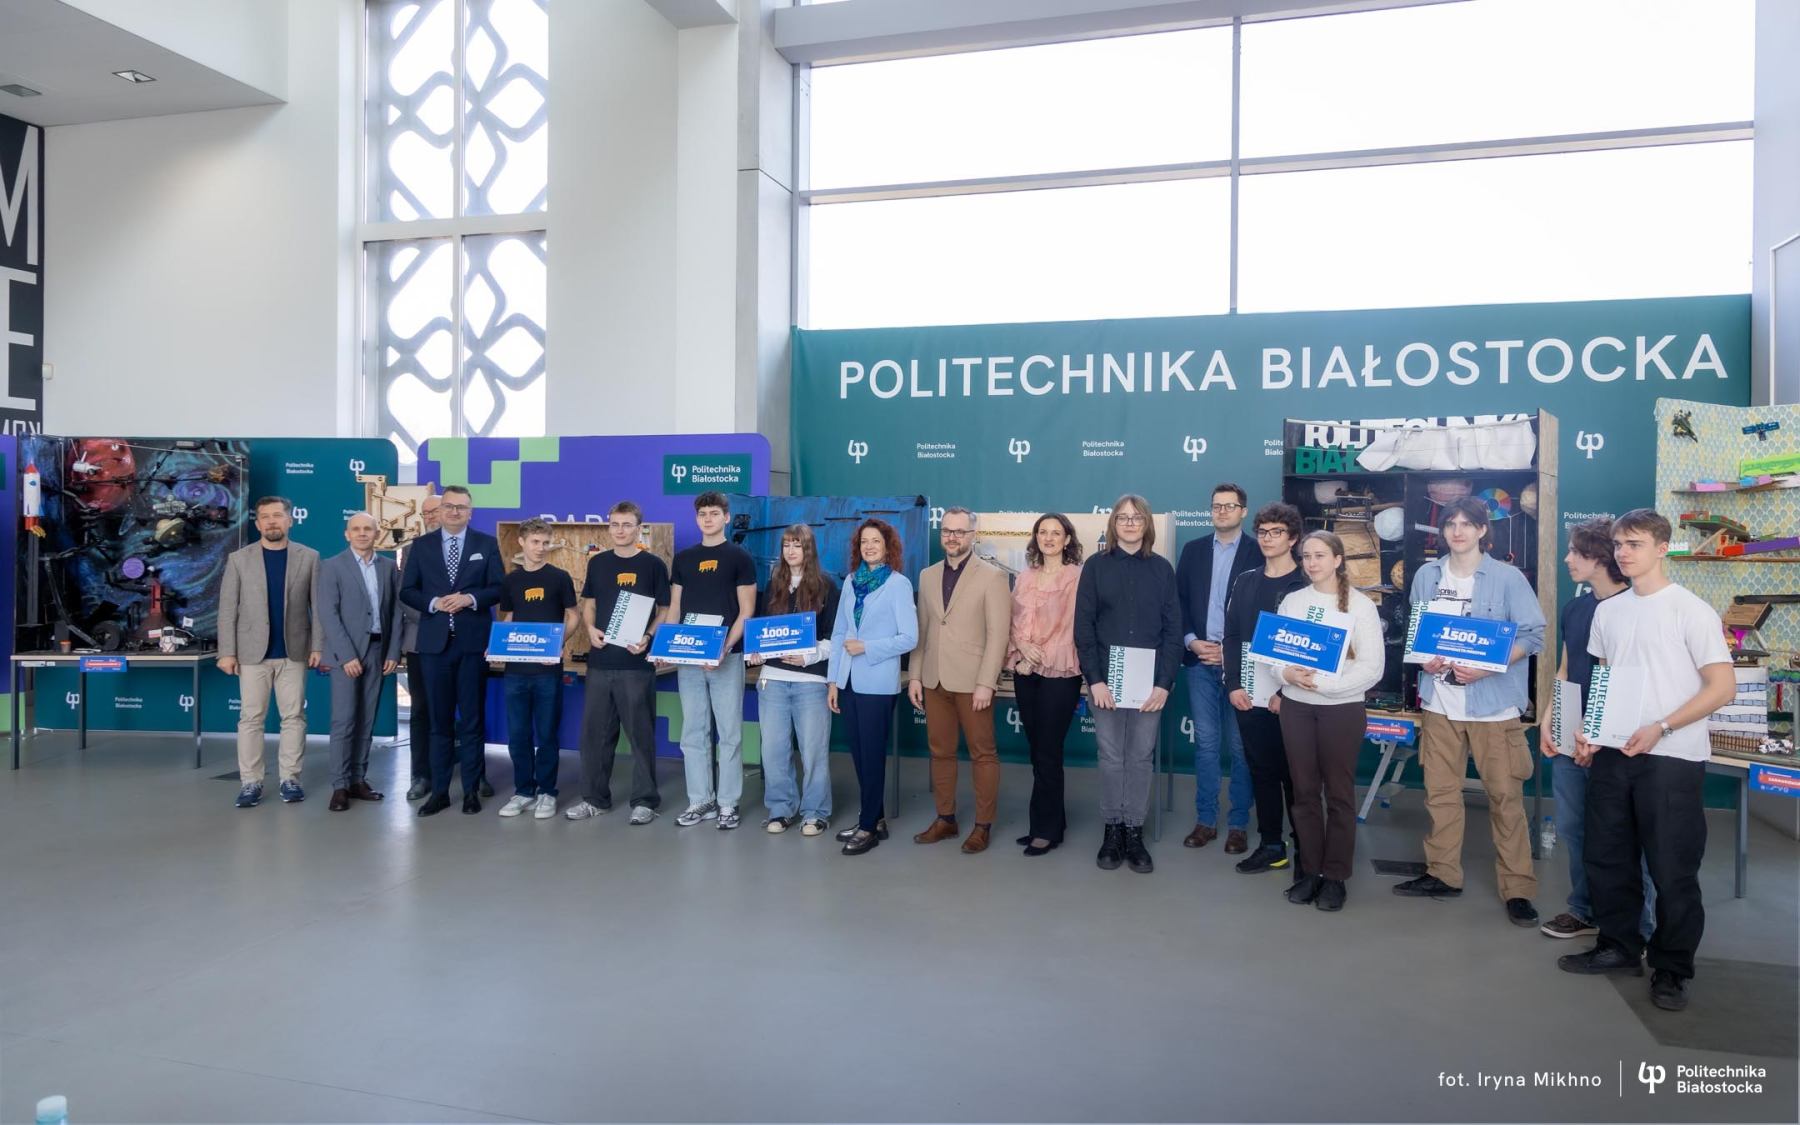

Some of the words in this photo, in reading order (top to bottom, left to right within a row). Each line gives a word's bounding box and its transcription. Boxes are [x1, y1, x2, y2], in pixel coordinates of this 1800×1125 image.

[840, 349, 1237, 399] POLITECHNIKA
[1262, 333, 1728, 390] BIAŁOSTOCKA
[916, 442, 956, 450] Politechnika
[1082, 440, 1125, 448] Politechnika
[917, 451, 955, 459] Białostocka
[1083, 449, 1124, 457] Białostocka
[692, 464, 741, 474] Politechnika
[692, 474, 739, 483] Białostocka
[611, 592, 632, 640] POLITECHNIKA
[508, 632, 537, 644] 5000
[761, 627, 789, 639] 1000
[1275, 628, 1311, 648] 2000
[1440, 626, 1478, 643] 1500
[673, 634, 695, 645] 500
[1115, 646, 1125, 703] POLITECHNIKA
[1583, 664, 1602, 734] BIAŁOSTOCKA
[1591, 665, 1611, 739] POLITECHNIKA
